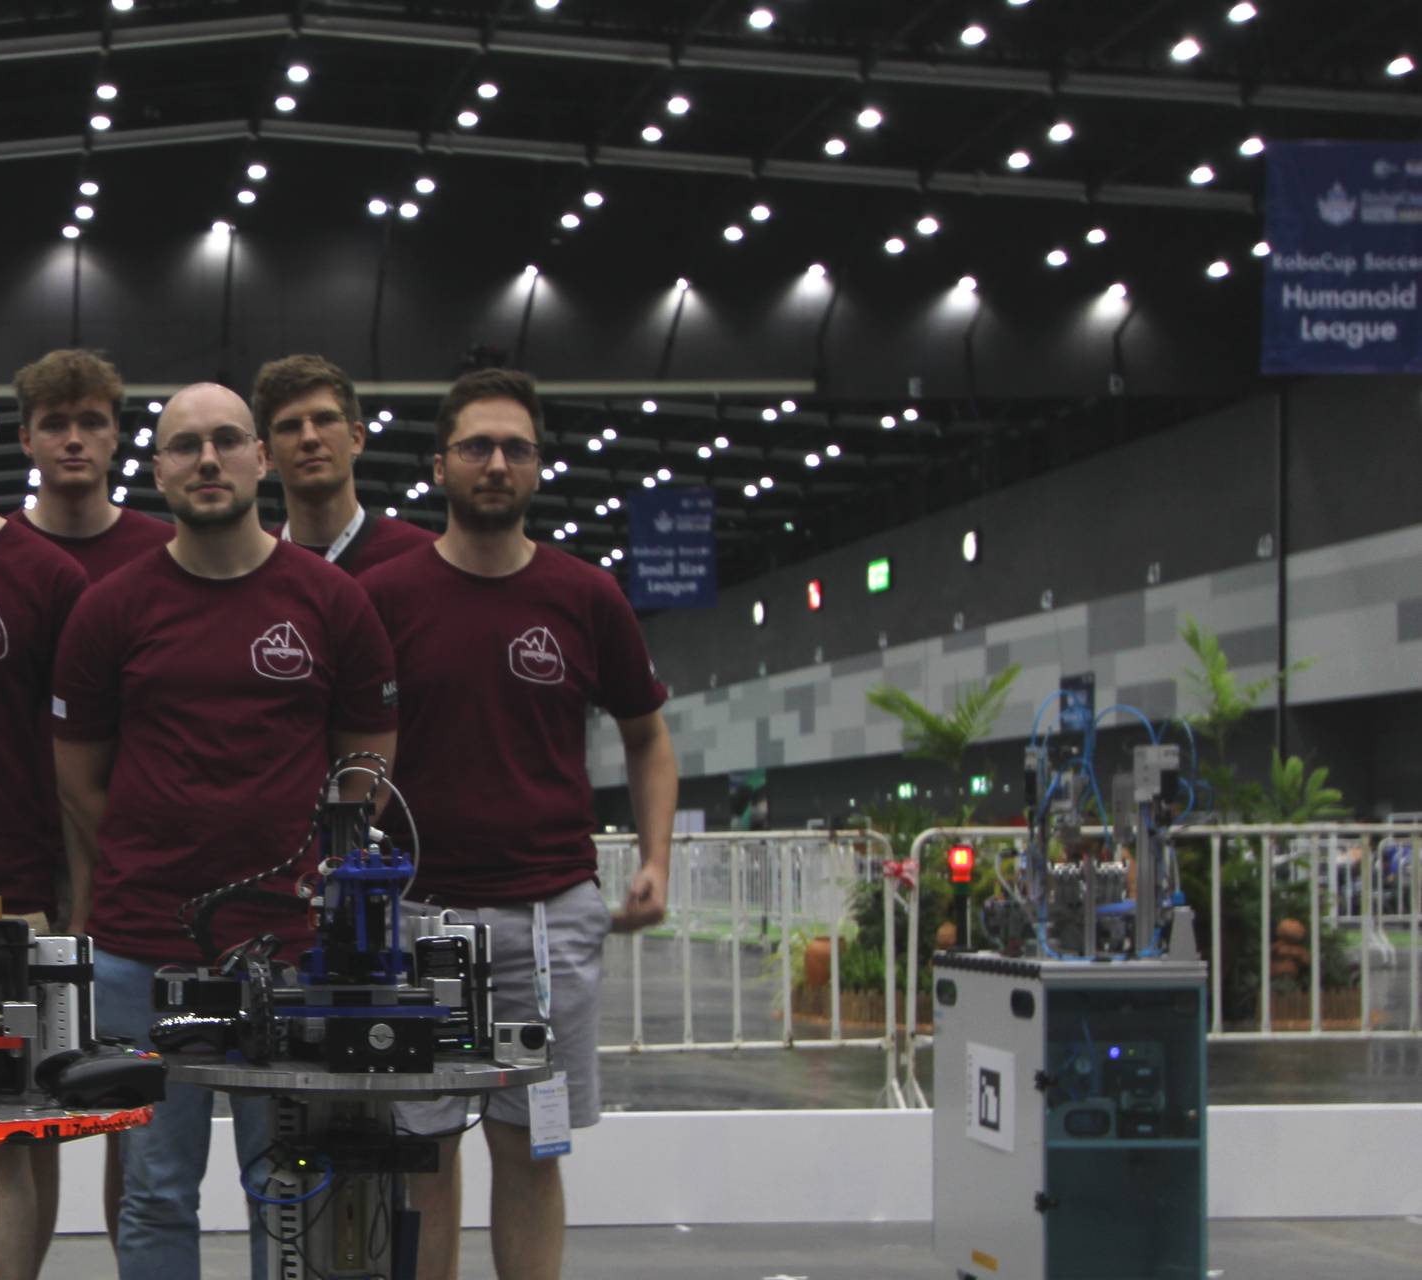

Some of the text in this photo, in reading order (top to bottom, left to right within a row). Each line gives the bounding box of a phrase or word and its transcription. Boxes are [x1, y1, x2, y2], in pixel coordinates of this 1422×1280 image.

[1273, 252, 1356, 276] RoboCup
[1282, 282, 1417, 309] Humanoid
[1300, 315, 1397, 349] League
[638, 561, 707, 577] Small Size
[646, 579, 697, 597] League
